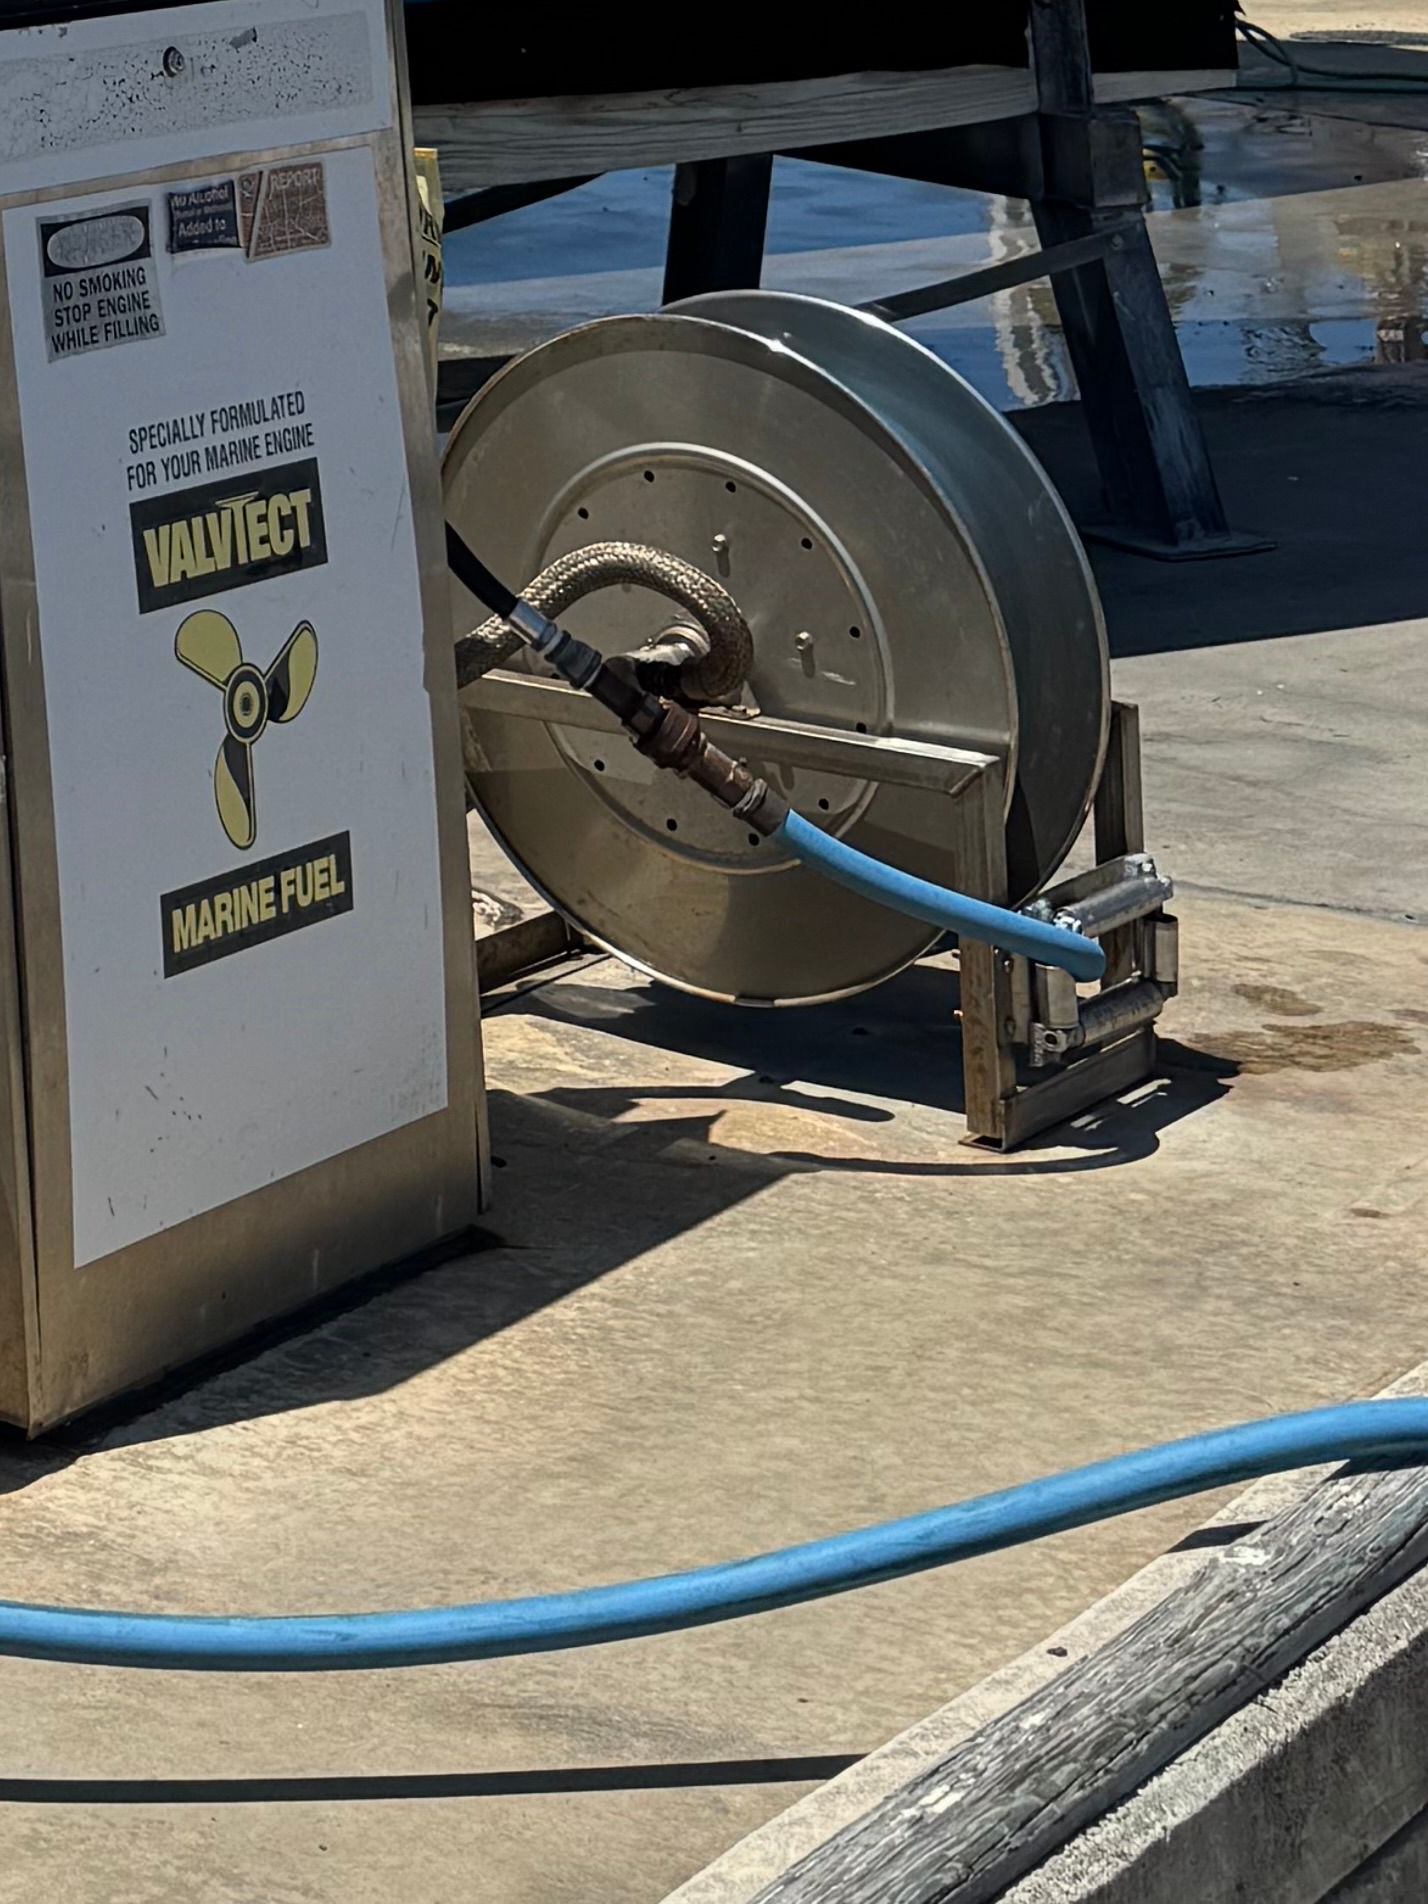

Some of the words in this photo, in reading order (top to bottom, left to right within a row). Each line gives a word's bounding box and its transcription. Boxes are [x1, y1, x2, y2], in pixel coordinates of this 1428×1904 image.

[178, 218, 213, 238] Added
[53, 282, 74, 304] NO
[79, 265, 146, 297] SMOKING
[54, 302, 91, 328] STOP
[97, 290, 151, 318] ENGINE
[51, 324, 98, 354] WHILE
[104, 313, 160, 343] FILLING
[128, 412, 206, 455] SPECIALLY
[210, 390, 306, 435] FORMULATED
[126, 460, 157, 491] FOR
[160, 450, 202, 482] YOUR
[205, 435, 262, 472] MARINE
[265, 422, 315, 456] ENGINE
[143, 488, 312, 589] VALVTECT
[171, 875, 277, 953] MARINE
[280, 854, 345, 914] FUEL
